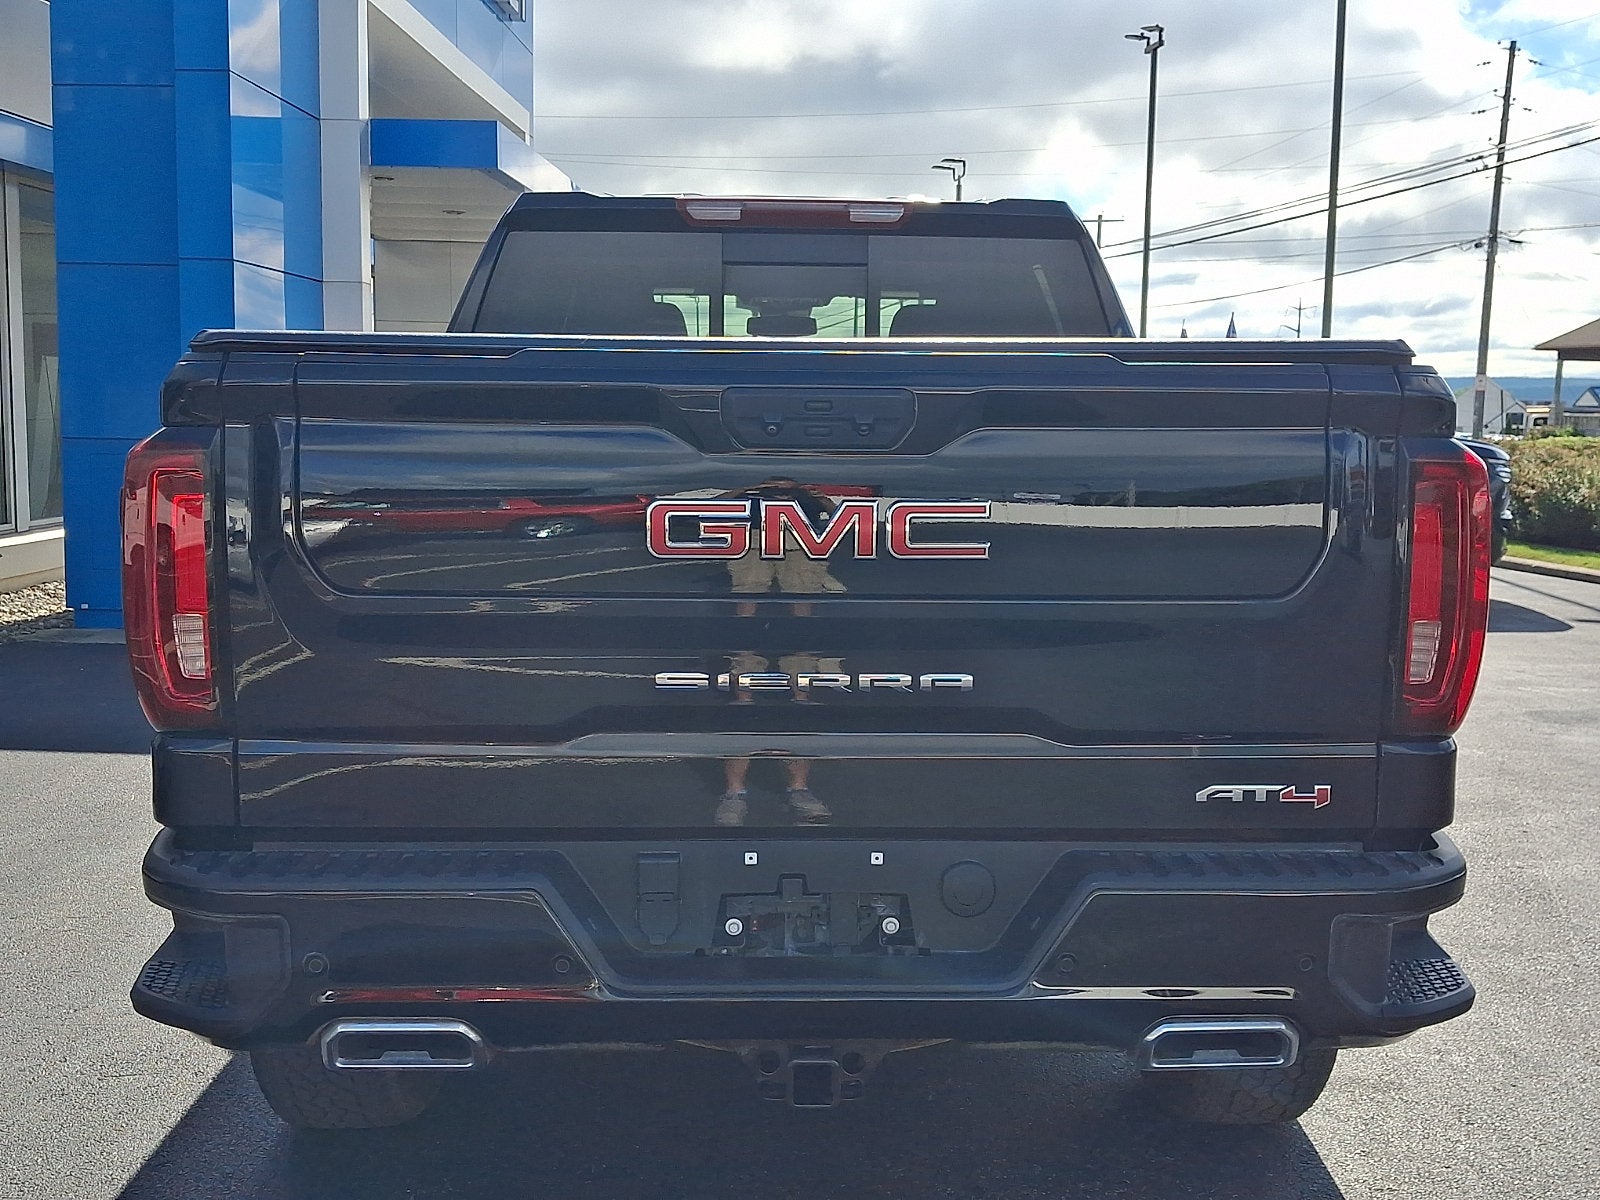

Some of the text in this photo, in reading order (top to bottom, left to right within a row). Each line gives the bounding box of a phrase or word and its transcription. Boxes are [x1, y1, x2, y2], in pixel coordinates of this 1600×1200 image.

[645, 499, 992, 560] GMC
[654, 671, 975, 693] SIERRA
[1195, 784, 1332, 810] AT4
